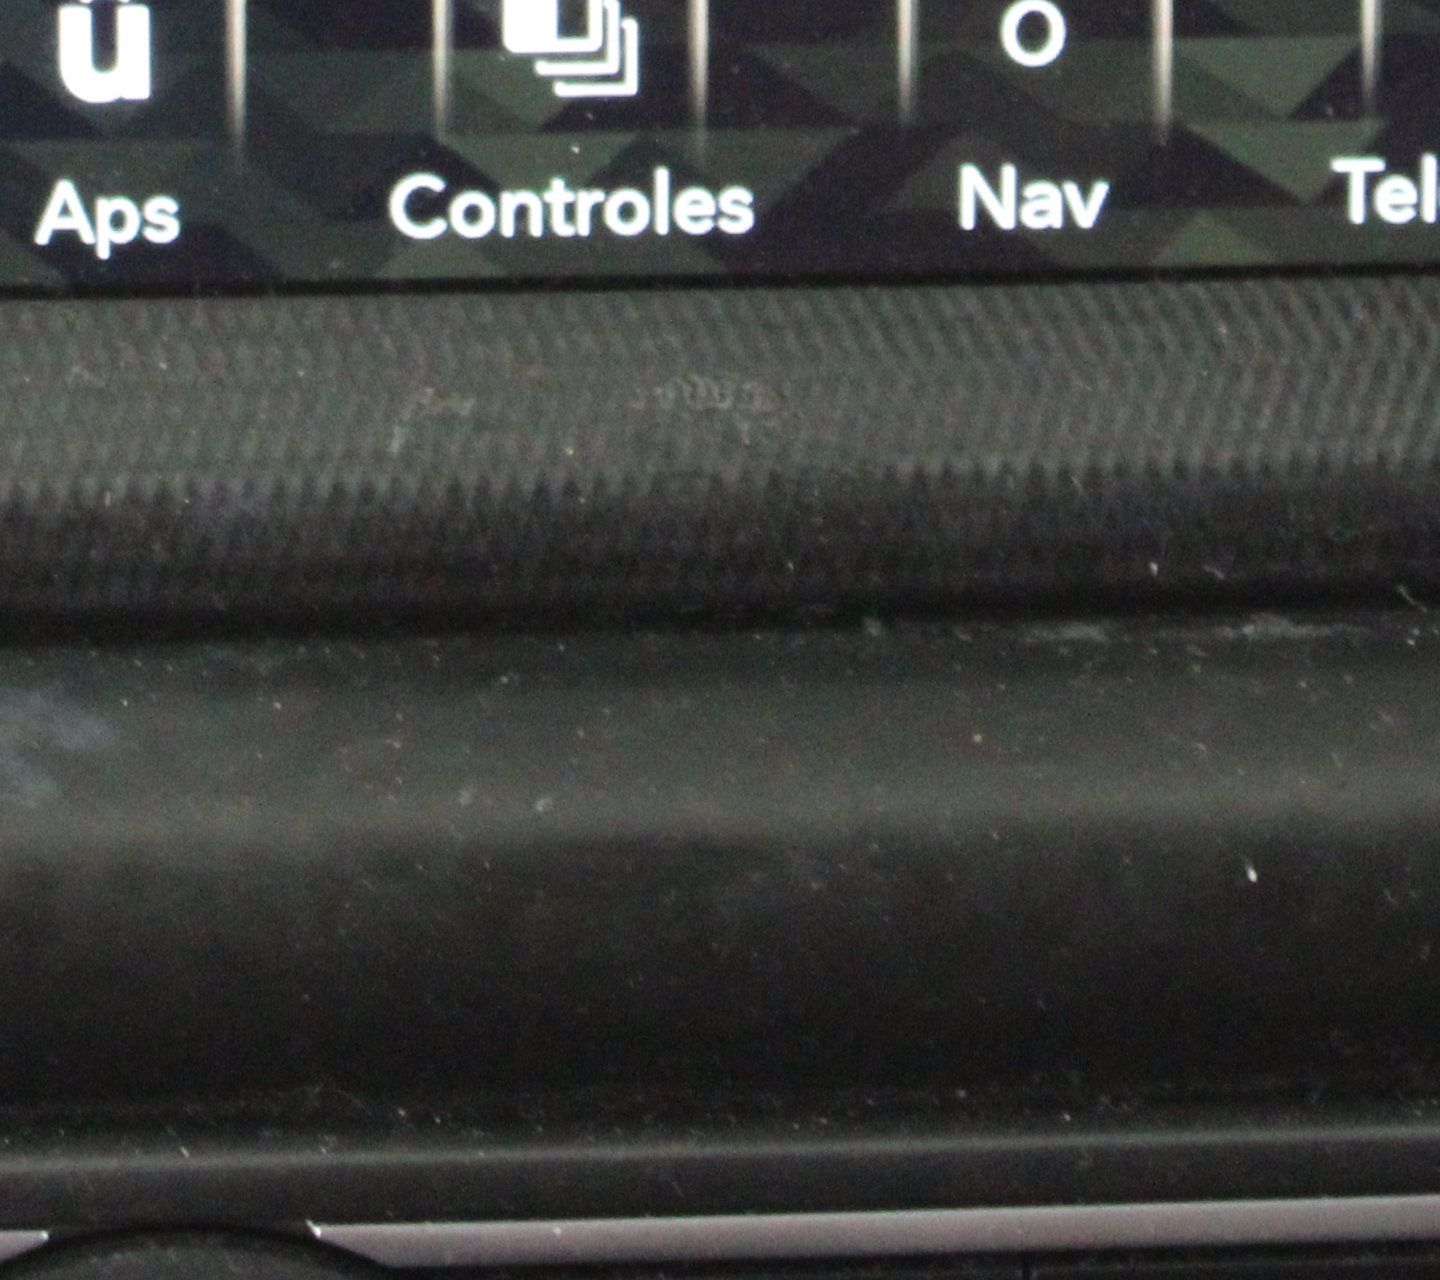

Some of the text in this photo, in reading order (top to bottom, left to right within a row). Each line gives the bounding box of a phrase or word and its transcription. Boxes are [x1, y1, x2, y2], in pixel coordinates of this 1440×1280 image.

[32, 177, 182, 262] Aps
[388, 166, 756, 241] Controles
[958, 162, 1111, 232] Nav
